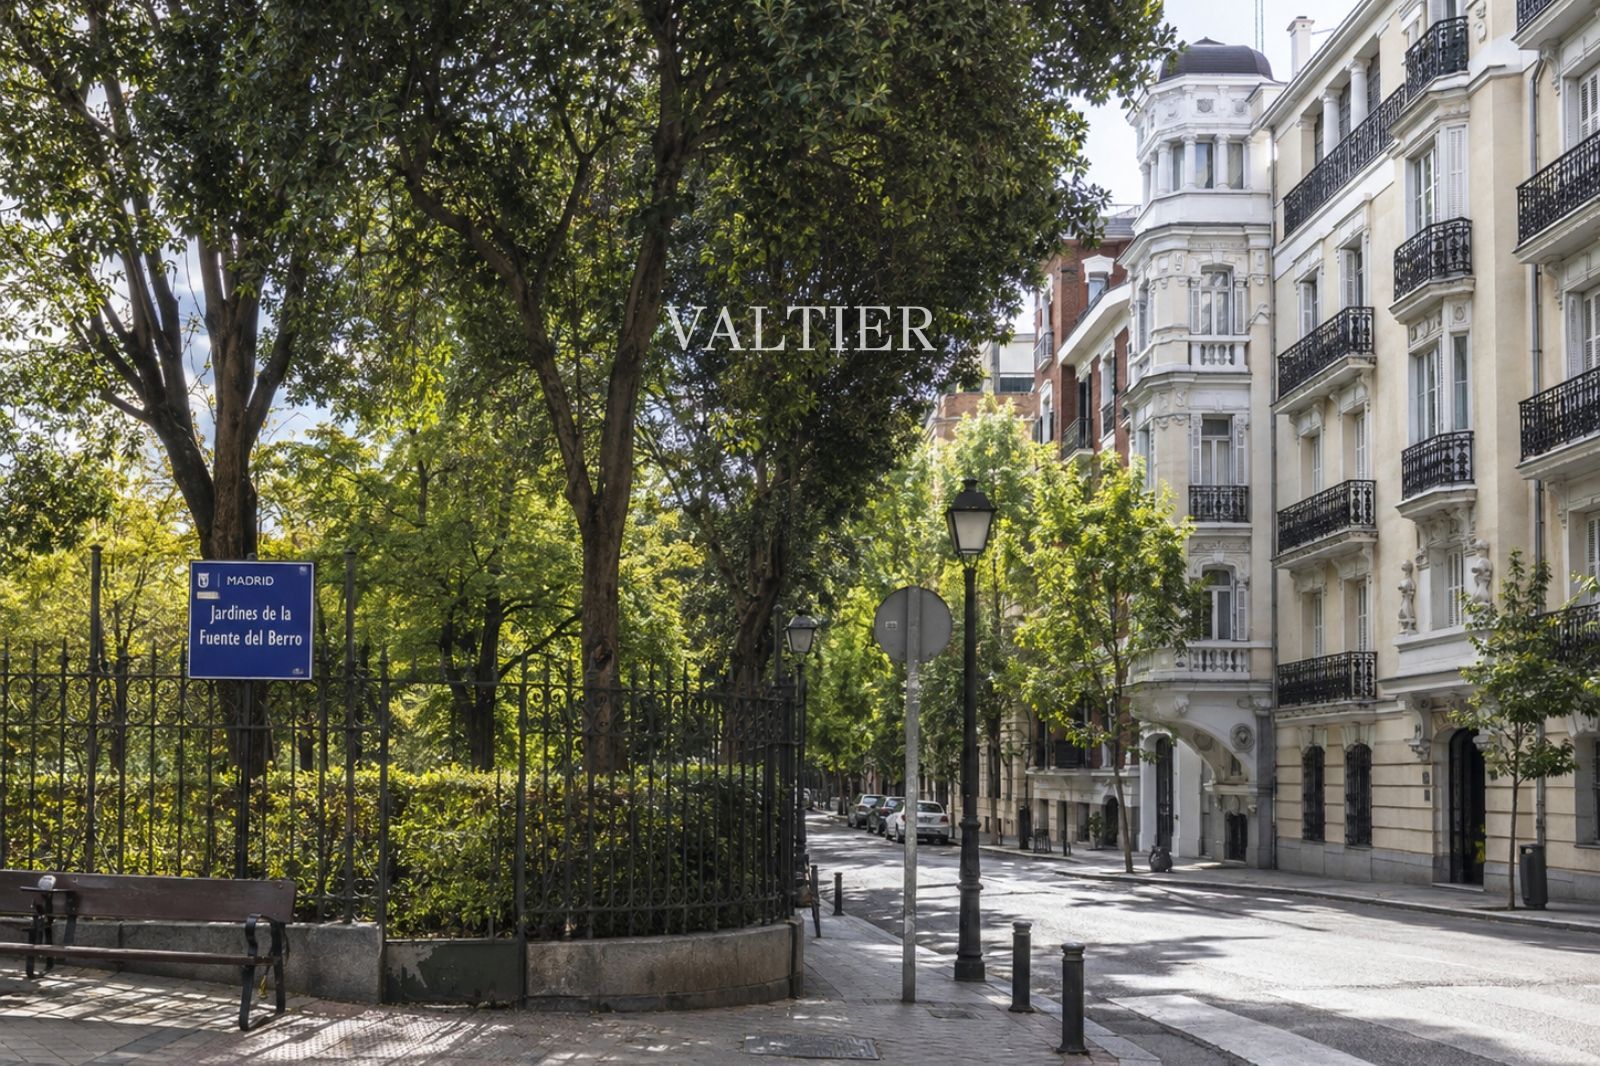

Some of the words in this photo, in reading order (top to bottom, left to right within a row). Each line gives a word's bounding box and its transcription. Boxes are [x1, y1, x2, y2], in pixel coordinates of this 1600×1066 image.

[226, 575, 275, 586] MADRID
[209, 604, 258, 625] Jardines
[262, 605, 277, 621] de
[281, 605, 292, 621] la
[199, 629, 240, 646] Fuente
[244, 629, 263, 646] del
[268, 629, 303, 646] Berro
